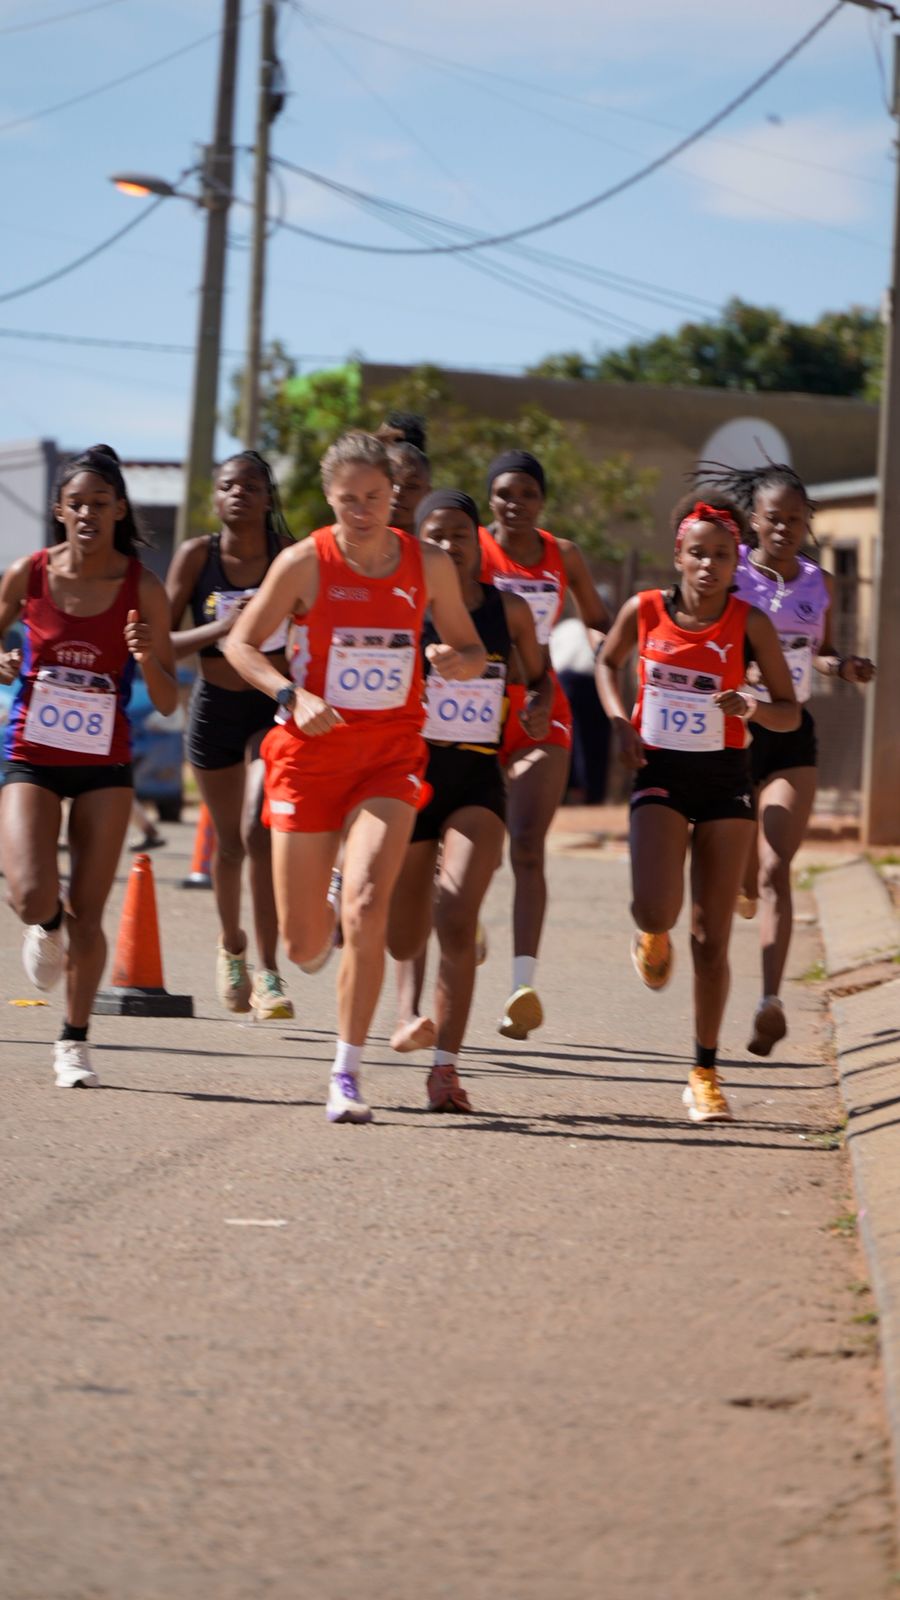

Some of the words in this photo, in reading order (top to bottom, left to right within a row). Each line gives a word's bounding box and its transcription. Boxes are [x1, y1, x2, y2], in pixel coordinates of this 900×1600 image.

[339, 668, 402, 691] 005
[39, 704, 103, 736] 008
[438, 698, 494, 723] 066
[660, 708, 706, 735] 193
